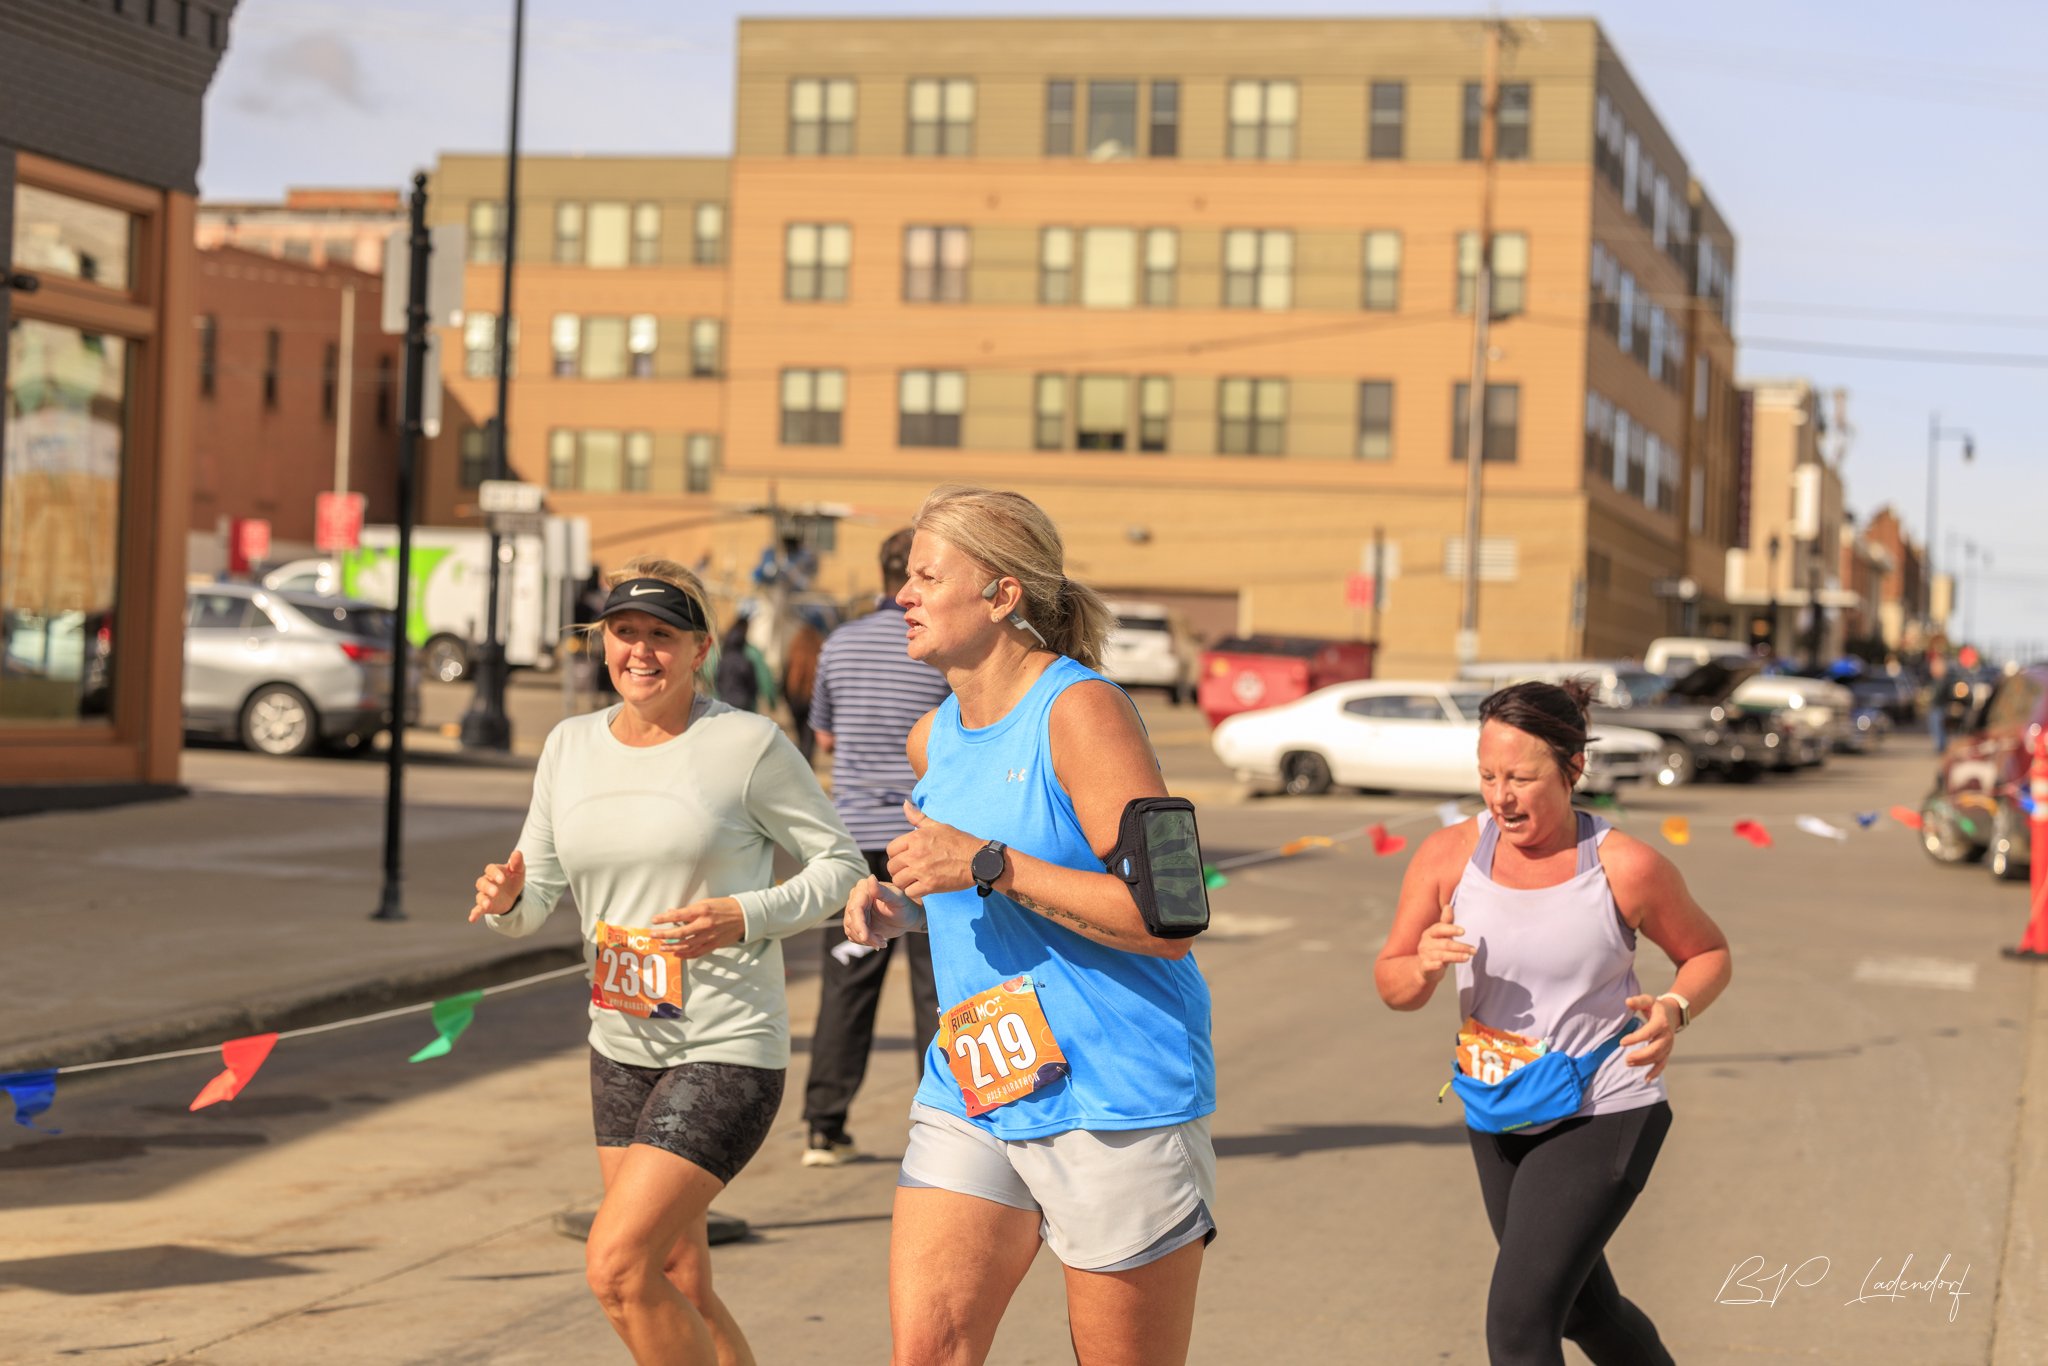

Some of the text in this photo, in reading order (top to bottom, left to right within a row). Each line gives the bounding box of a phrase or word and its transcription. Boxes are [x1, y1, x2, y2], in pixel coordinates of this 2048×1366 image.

[602, 948, 667, 1000] 230
[954, 1012, 1038, 1090] 219
[986, 1072, 1040, 1103] HALF MARATHON
